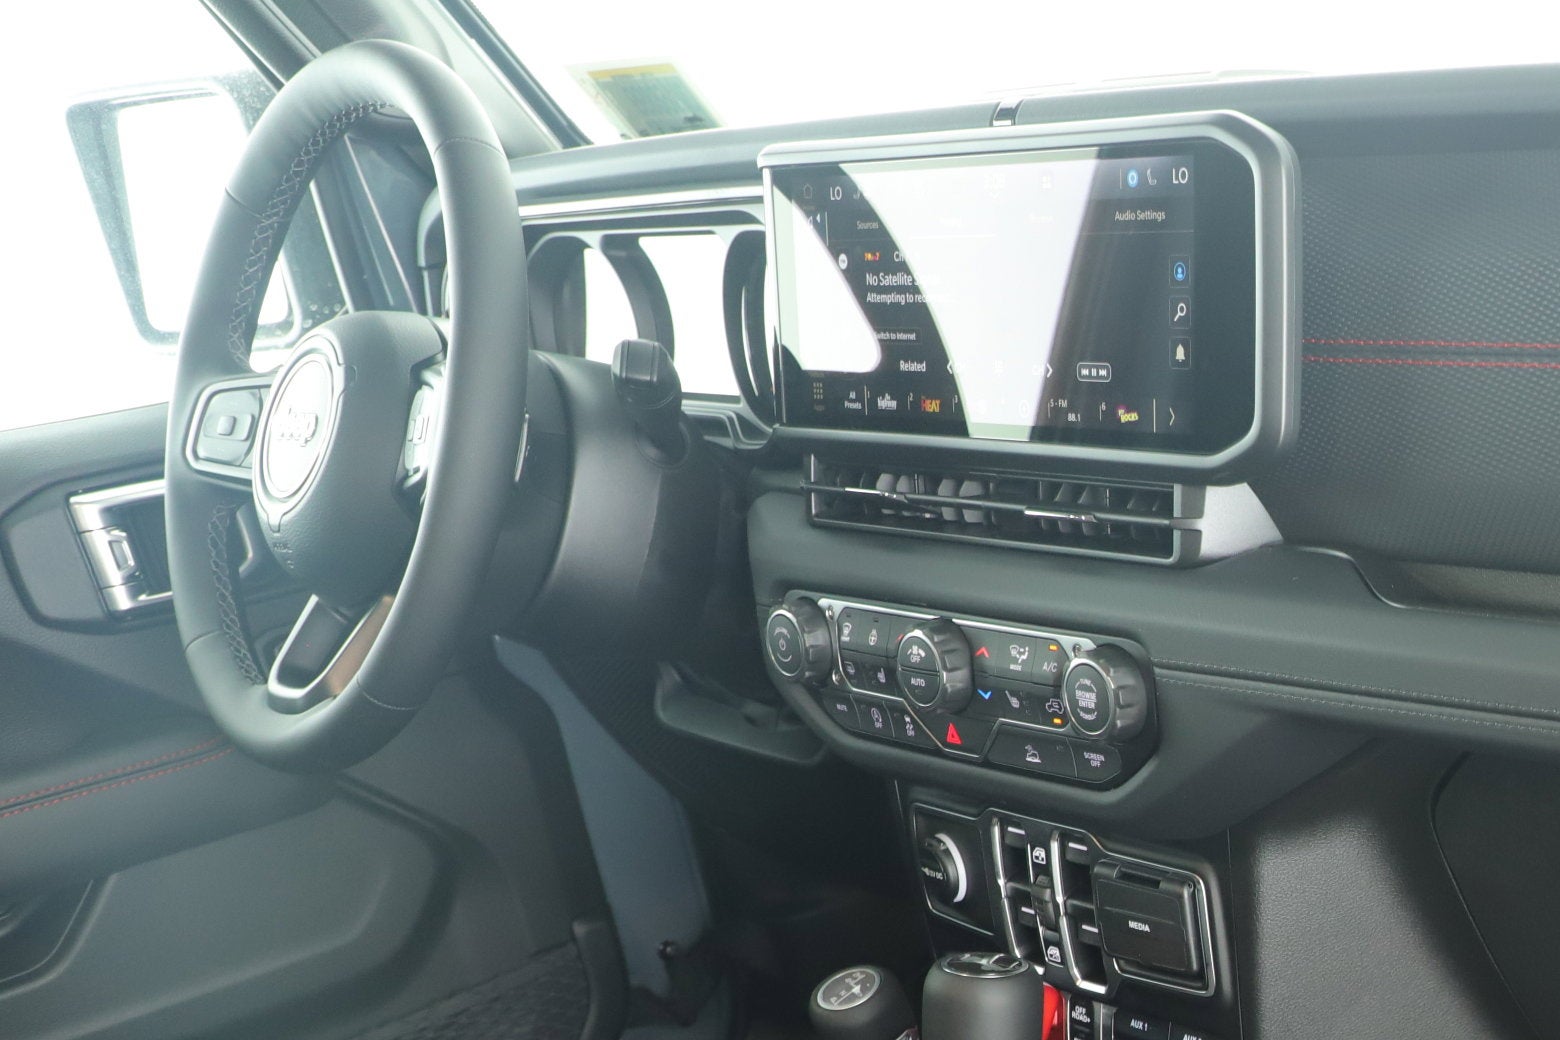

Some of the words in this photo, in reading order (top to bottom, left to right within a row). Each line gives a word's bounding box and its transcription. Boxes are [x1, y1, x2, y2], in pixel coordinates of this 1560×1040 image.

[1172, 167, 1189, 184] LO
[829, 186, 843, 201] LO
[1114, 209, 1136, 221] Audio
[1136, 208, 1166, 222] Settings
[856, 220, 879, 230] Sources
[866, 273, 878, 286] No
[879, 271, 913, 286] Satellite
[866, 291, 906, 305] Attempting
[906, 292, 914, 303] to
[900, 360, 926, 372] Related
[844, 400, 862, 410] Presets
[921, 399, 941, 412] HEAT
[1058, 399, 1068, 408] FM
[1067, 412, 1081, 422] 88.1
[910, 654, 921, 664] OFF
[1009, 663, 1022, 672] MODE
[1042, 662, 1058, 673] A/C
[910, 677, 926, 687] AUTO
[1075, 689, 1097, 700] BROWSE
[1078, 700, 1096, 709] ENTER
[1083, 751, 1105, 762] SCREEN
[1090, 759, 1101, 768] OFF
[1128, 919, 1151, 933] MEDIA
[1074, 1004, 1087, 1015] OFF
[1129, 1018, 1144, 1030] AUX
